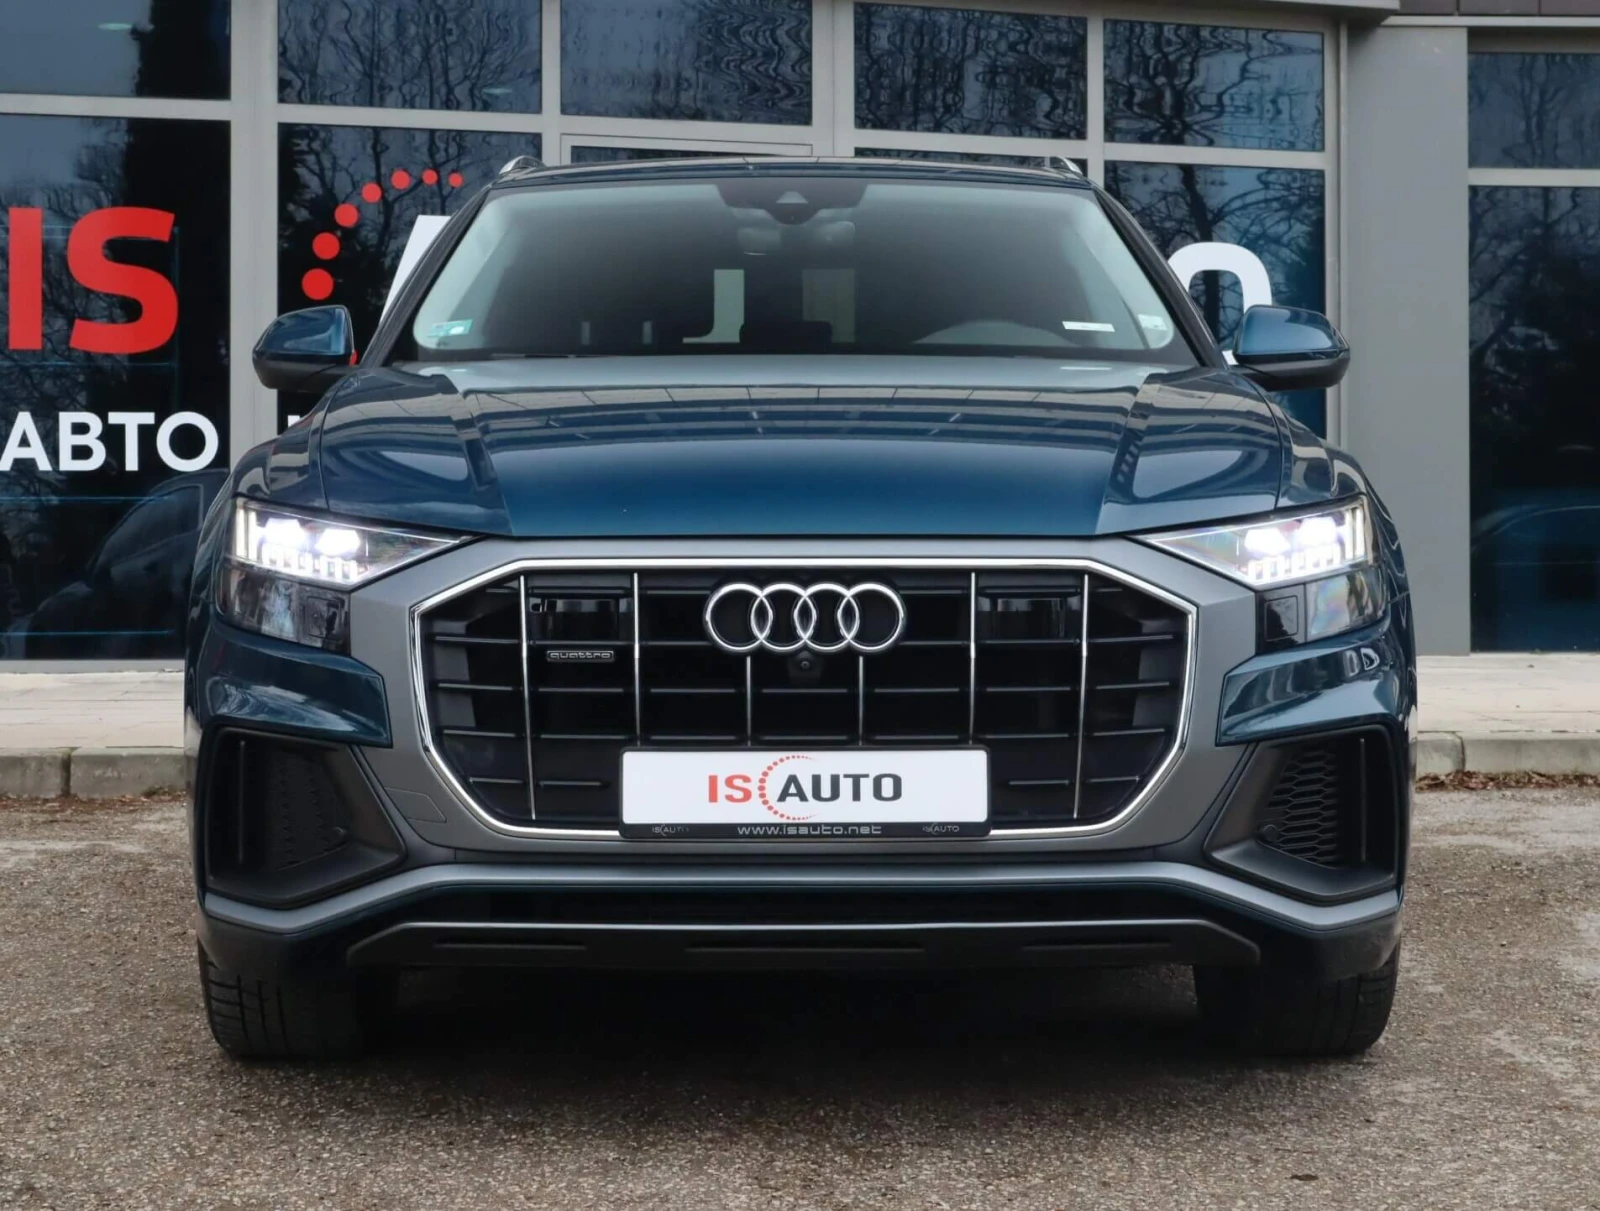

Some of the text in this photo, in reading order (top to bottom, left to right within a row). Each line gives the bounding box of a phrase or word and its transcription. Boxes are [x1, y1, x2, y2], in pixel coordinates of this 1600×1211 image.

[8, 206, 179, 354] IS
[0, 411, 219, 472] АВТО
[549, 651, 612, 660] quattro
[708, 773, 903, 803] IS AUTO
[737, 824, 882, 835] www.isauto.net
